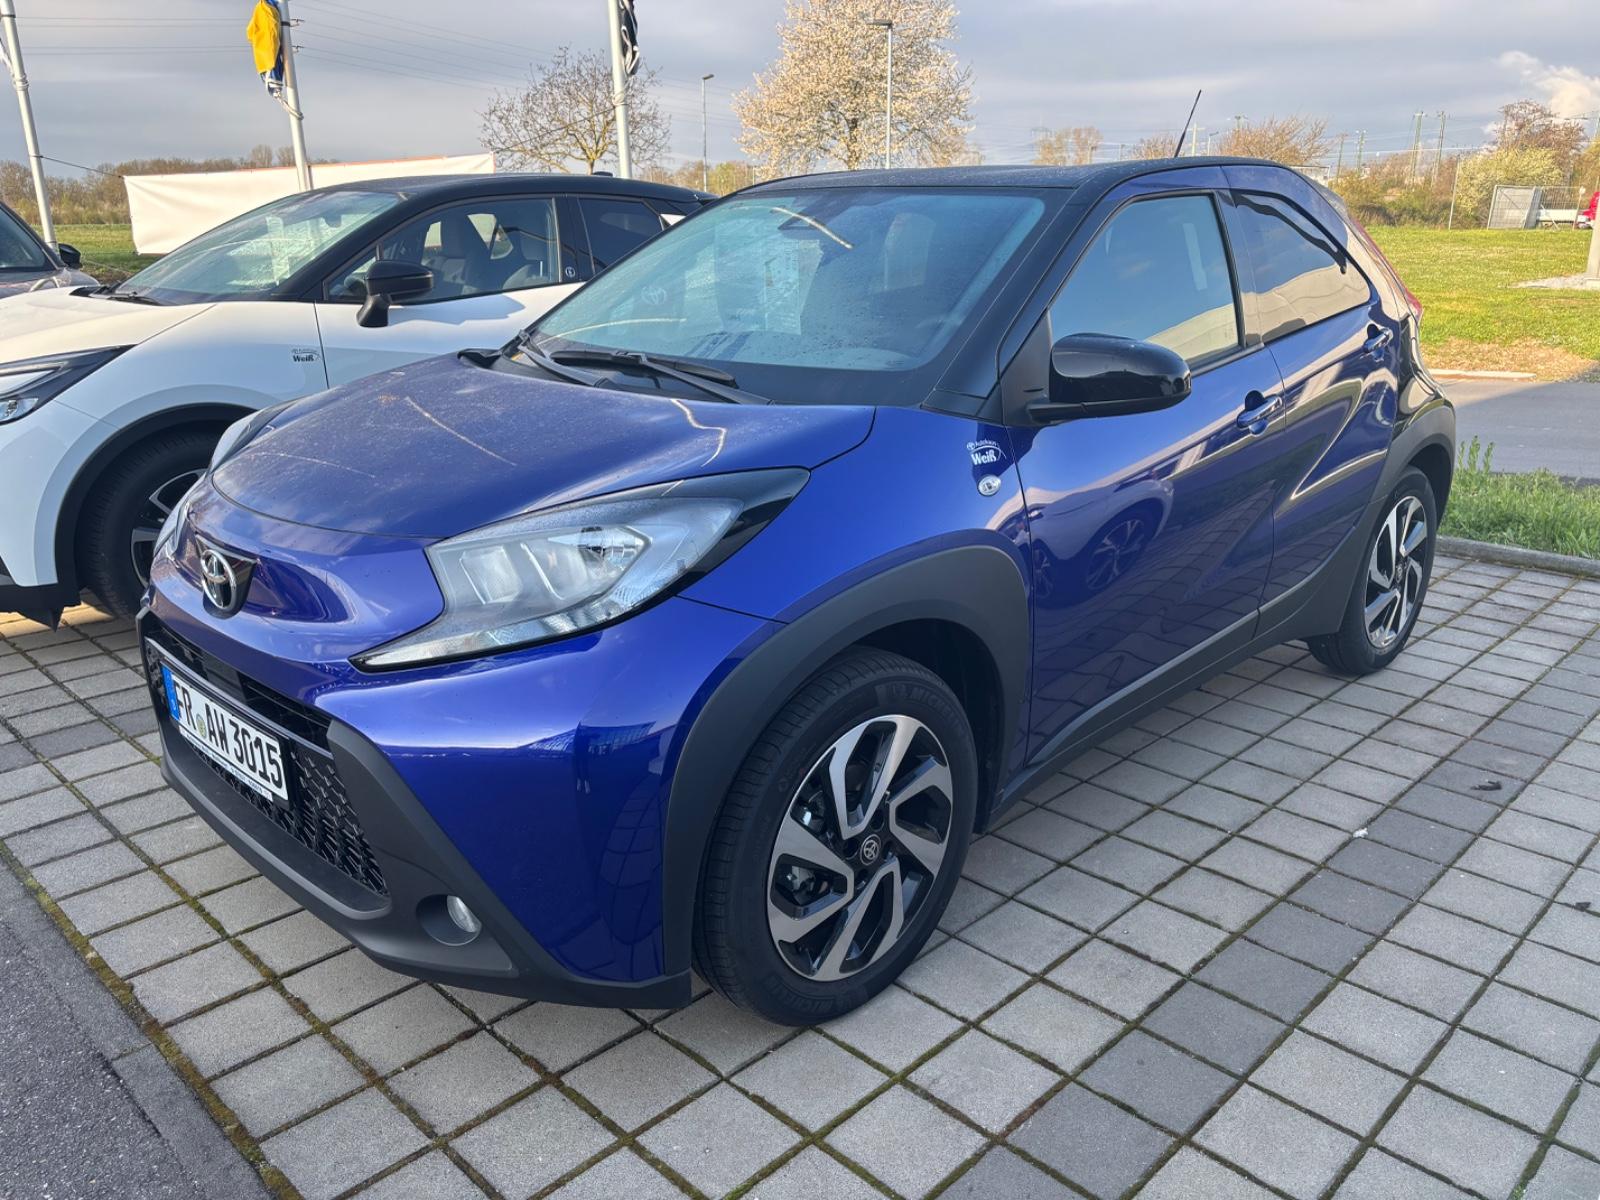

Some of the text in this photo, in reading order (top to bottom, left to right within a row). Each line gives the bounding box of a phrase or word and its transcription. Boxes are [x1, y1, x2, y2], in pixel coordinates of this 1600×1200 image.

[971, 449, 997, 465] Weiß
[173, 681, 196, 730] FR
[229, 721, 283, 790] 3015
